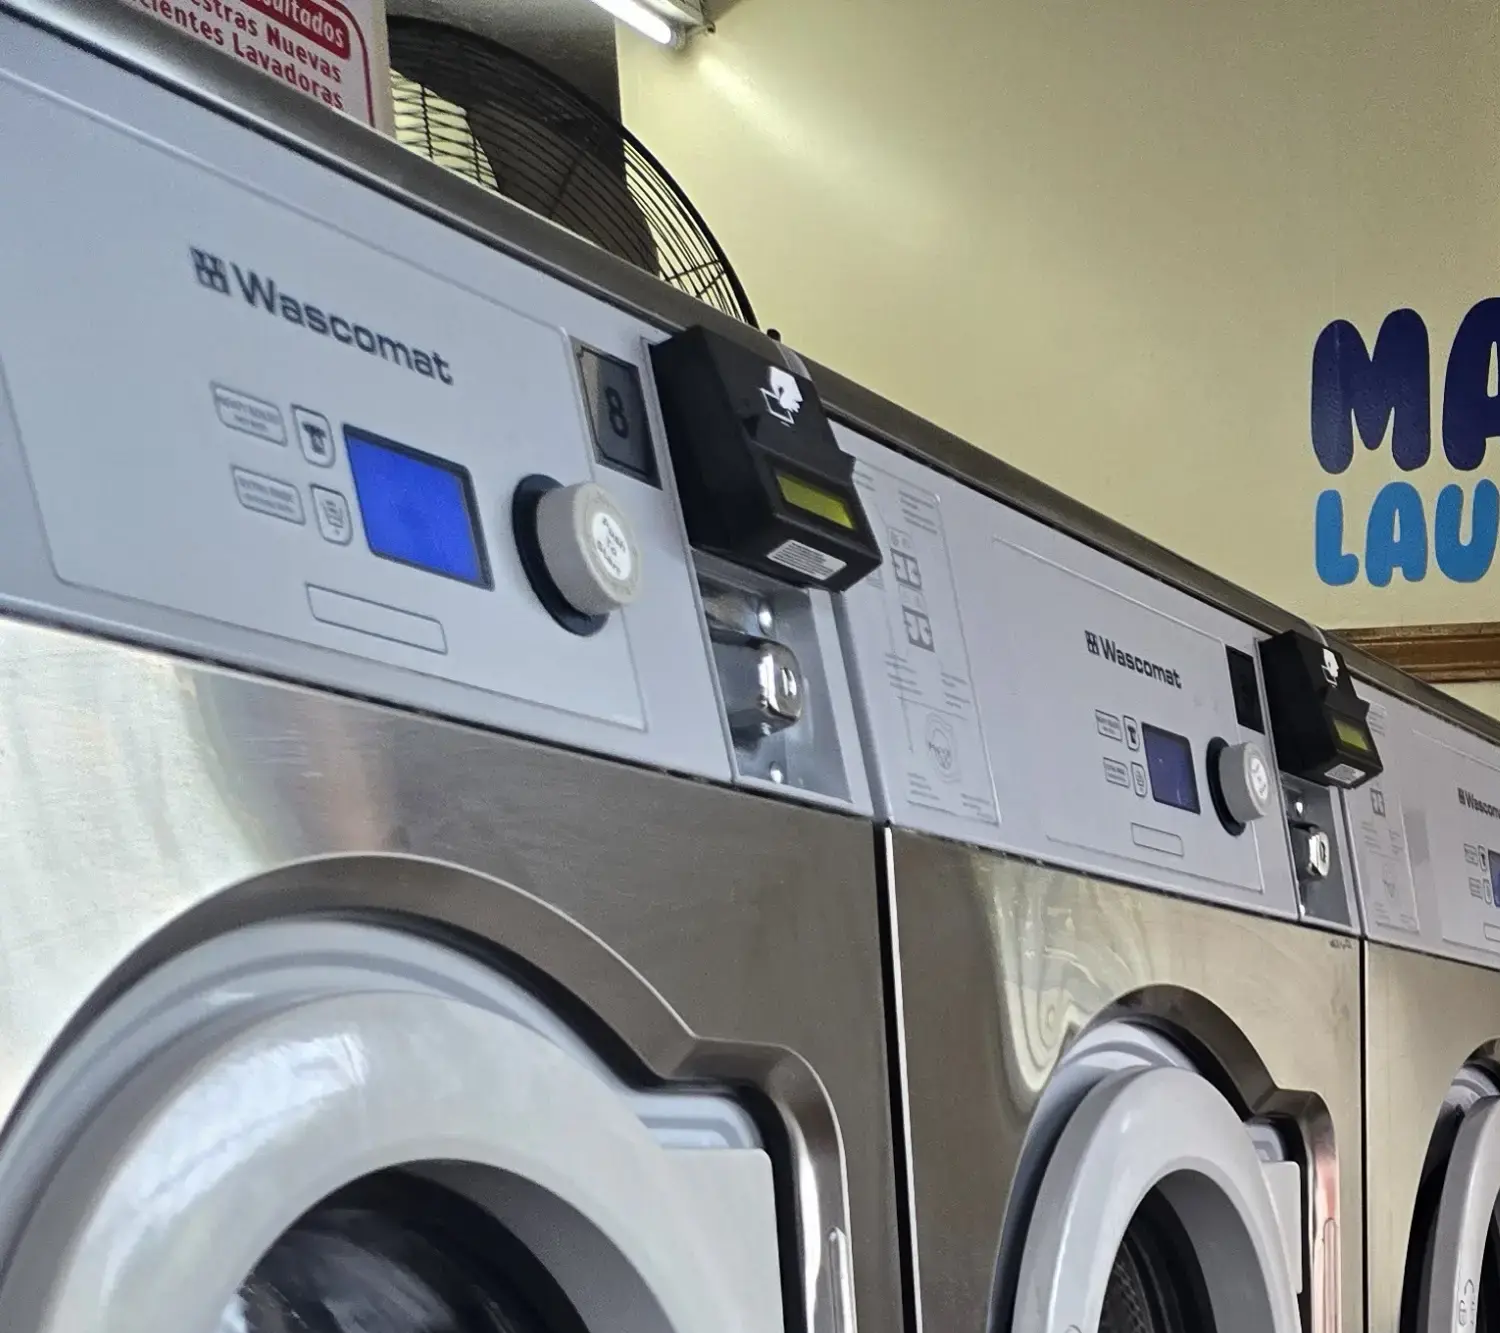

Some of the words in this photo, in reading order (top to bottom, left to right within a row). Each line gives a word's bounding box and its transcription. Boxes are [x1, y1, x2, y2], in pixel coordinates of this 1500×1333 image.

[232, 32, 343, 109] Lavadoras
[266, 22, 341, 84] Nuevas
[230, 261, 453, 385] Wascomat
[604, 386, 630, 440] 8
[1099, 635, 1182, 689] Wascomat
